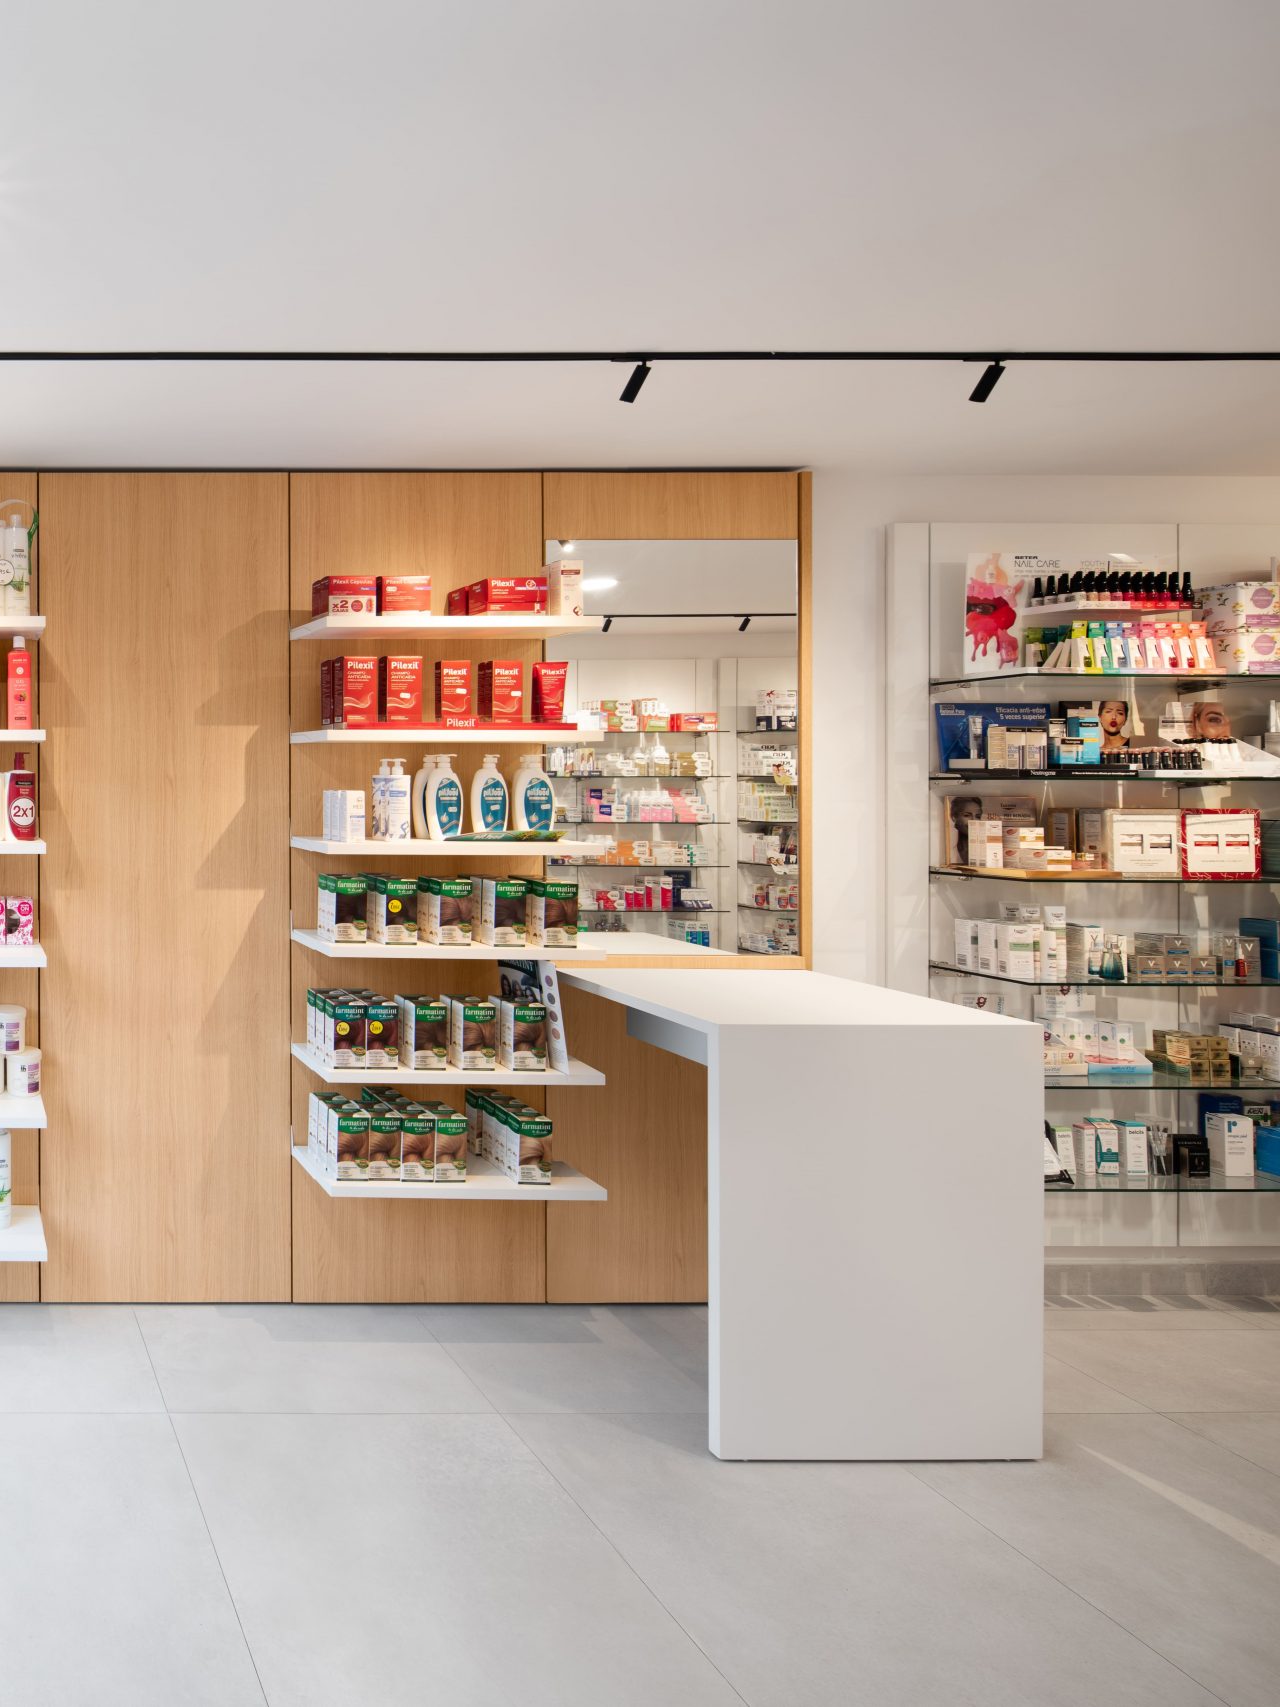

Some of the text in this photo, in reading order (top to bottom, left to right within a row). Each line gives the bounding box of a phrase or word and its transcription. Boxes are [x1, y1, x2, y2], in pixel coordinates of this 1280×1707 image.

[1014, 560, 1060, 568] NAIL CARE
[1081, 560, 1105, 568] YOUTH
[491, 579, 515, 587] Pilexil
[332, 600, 349, 609] x2
[347, 661, 374, 670] Pilexil
[391, 661, 419, 670] Pilexil
[446, 718, 476, 727] Pilexil
[13, 805, 34, 818] 2x1
[337, 880, 367, 888] farmatint
[387, 881, 417, 890] farmatint
[442, 883, 471, 891] farmatint
[496, 884, 526, 892] farmatint
[546, 885, 577, 893] farmatint
[335, 1006, 364, 1014] farmatint
[368, 1006, 397, 1014] farmatint
[416, 1007, 446, 1015] farmatint
[465, 1008, 494, 1016] farmatint
[515, 1008, 545, 1016] farmatint
[339, 1118, 368, 1127] farmatint
[371, 1118, 401, 1126] farmatint
[404, 1120, 433, 1128] farmatint
[438, 1120, 466, 1128] farmatint
[521, 1122, 551, 1130] farmatint
